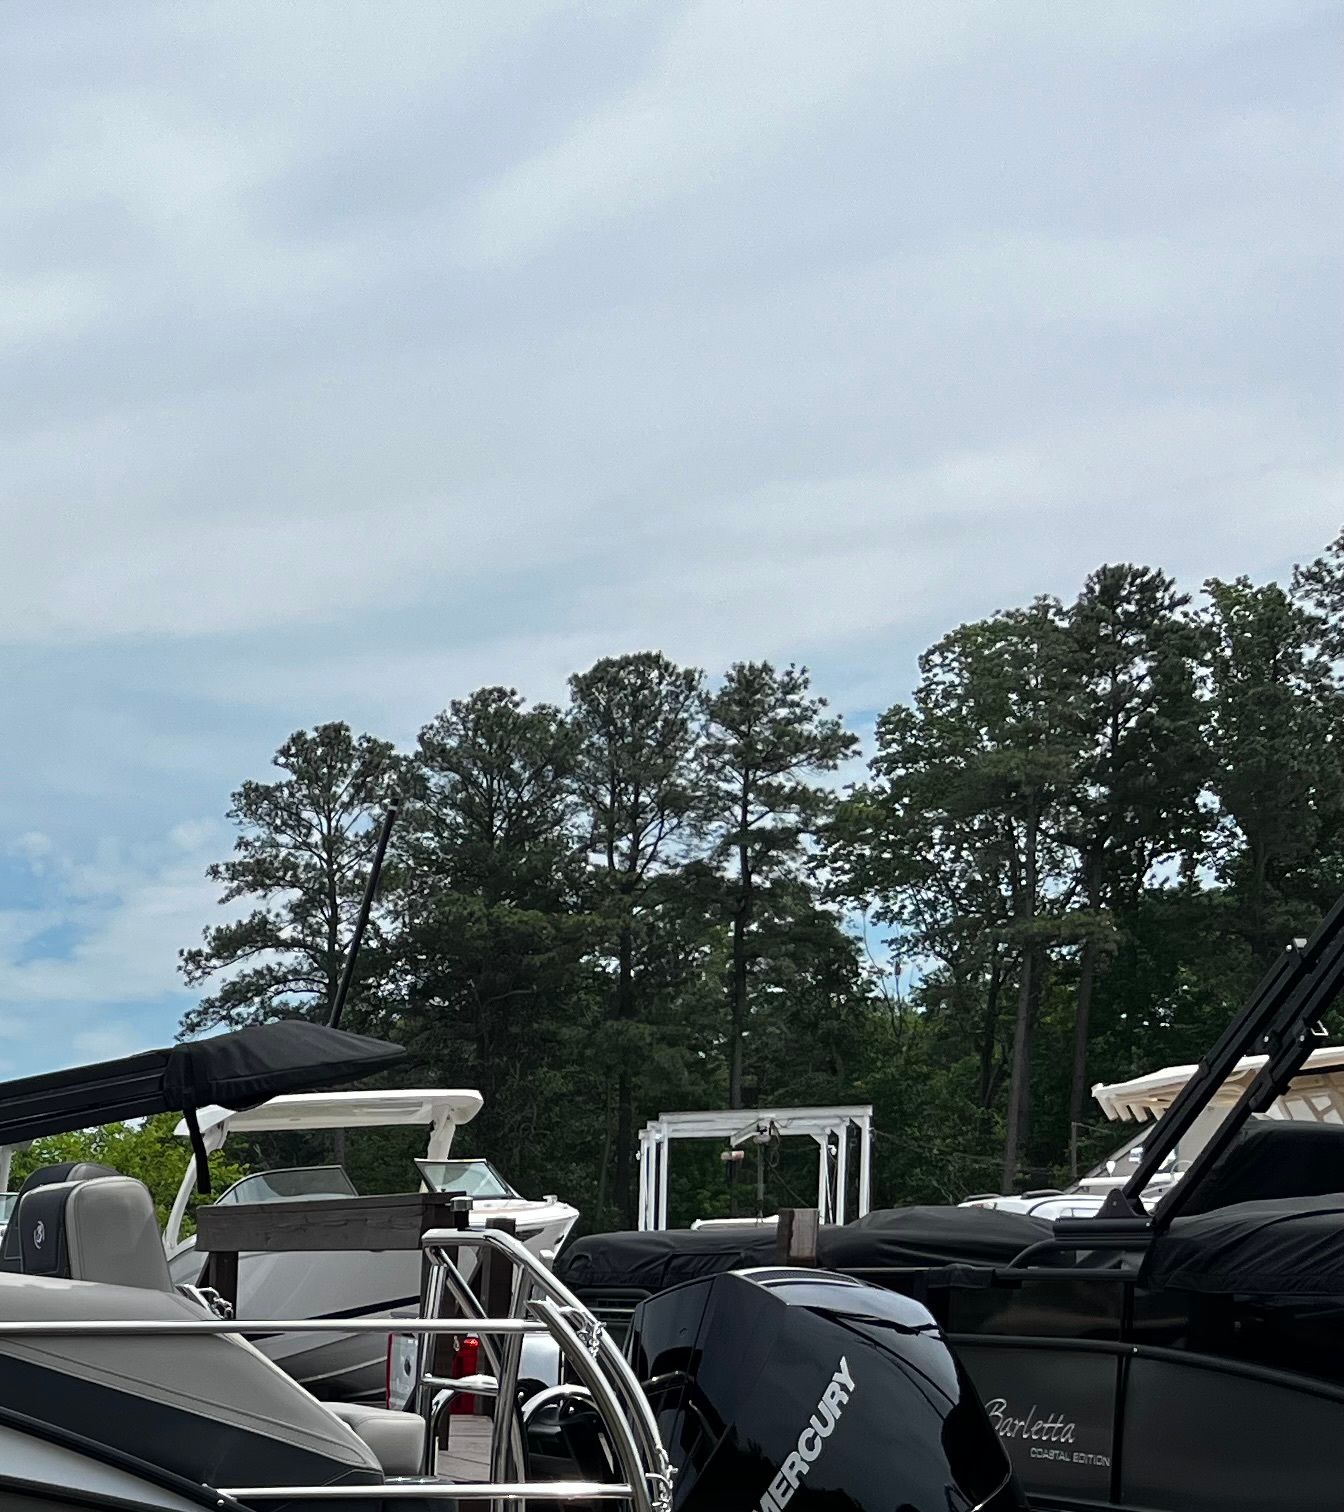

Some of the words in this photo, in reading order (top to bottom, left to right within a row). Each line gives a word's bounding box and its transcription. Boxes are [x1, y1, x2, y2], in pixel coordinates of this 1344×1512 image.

[984, 1397, 1076, 1443] Barletta
[1029, 1447, 1072, 1462] COASTAL
[1072, 1451, 1111, 1467] EDITION
